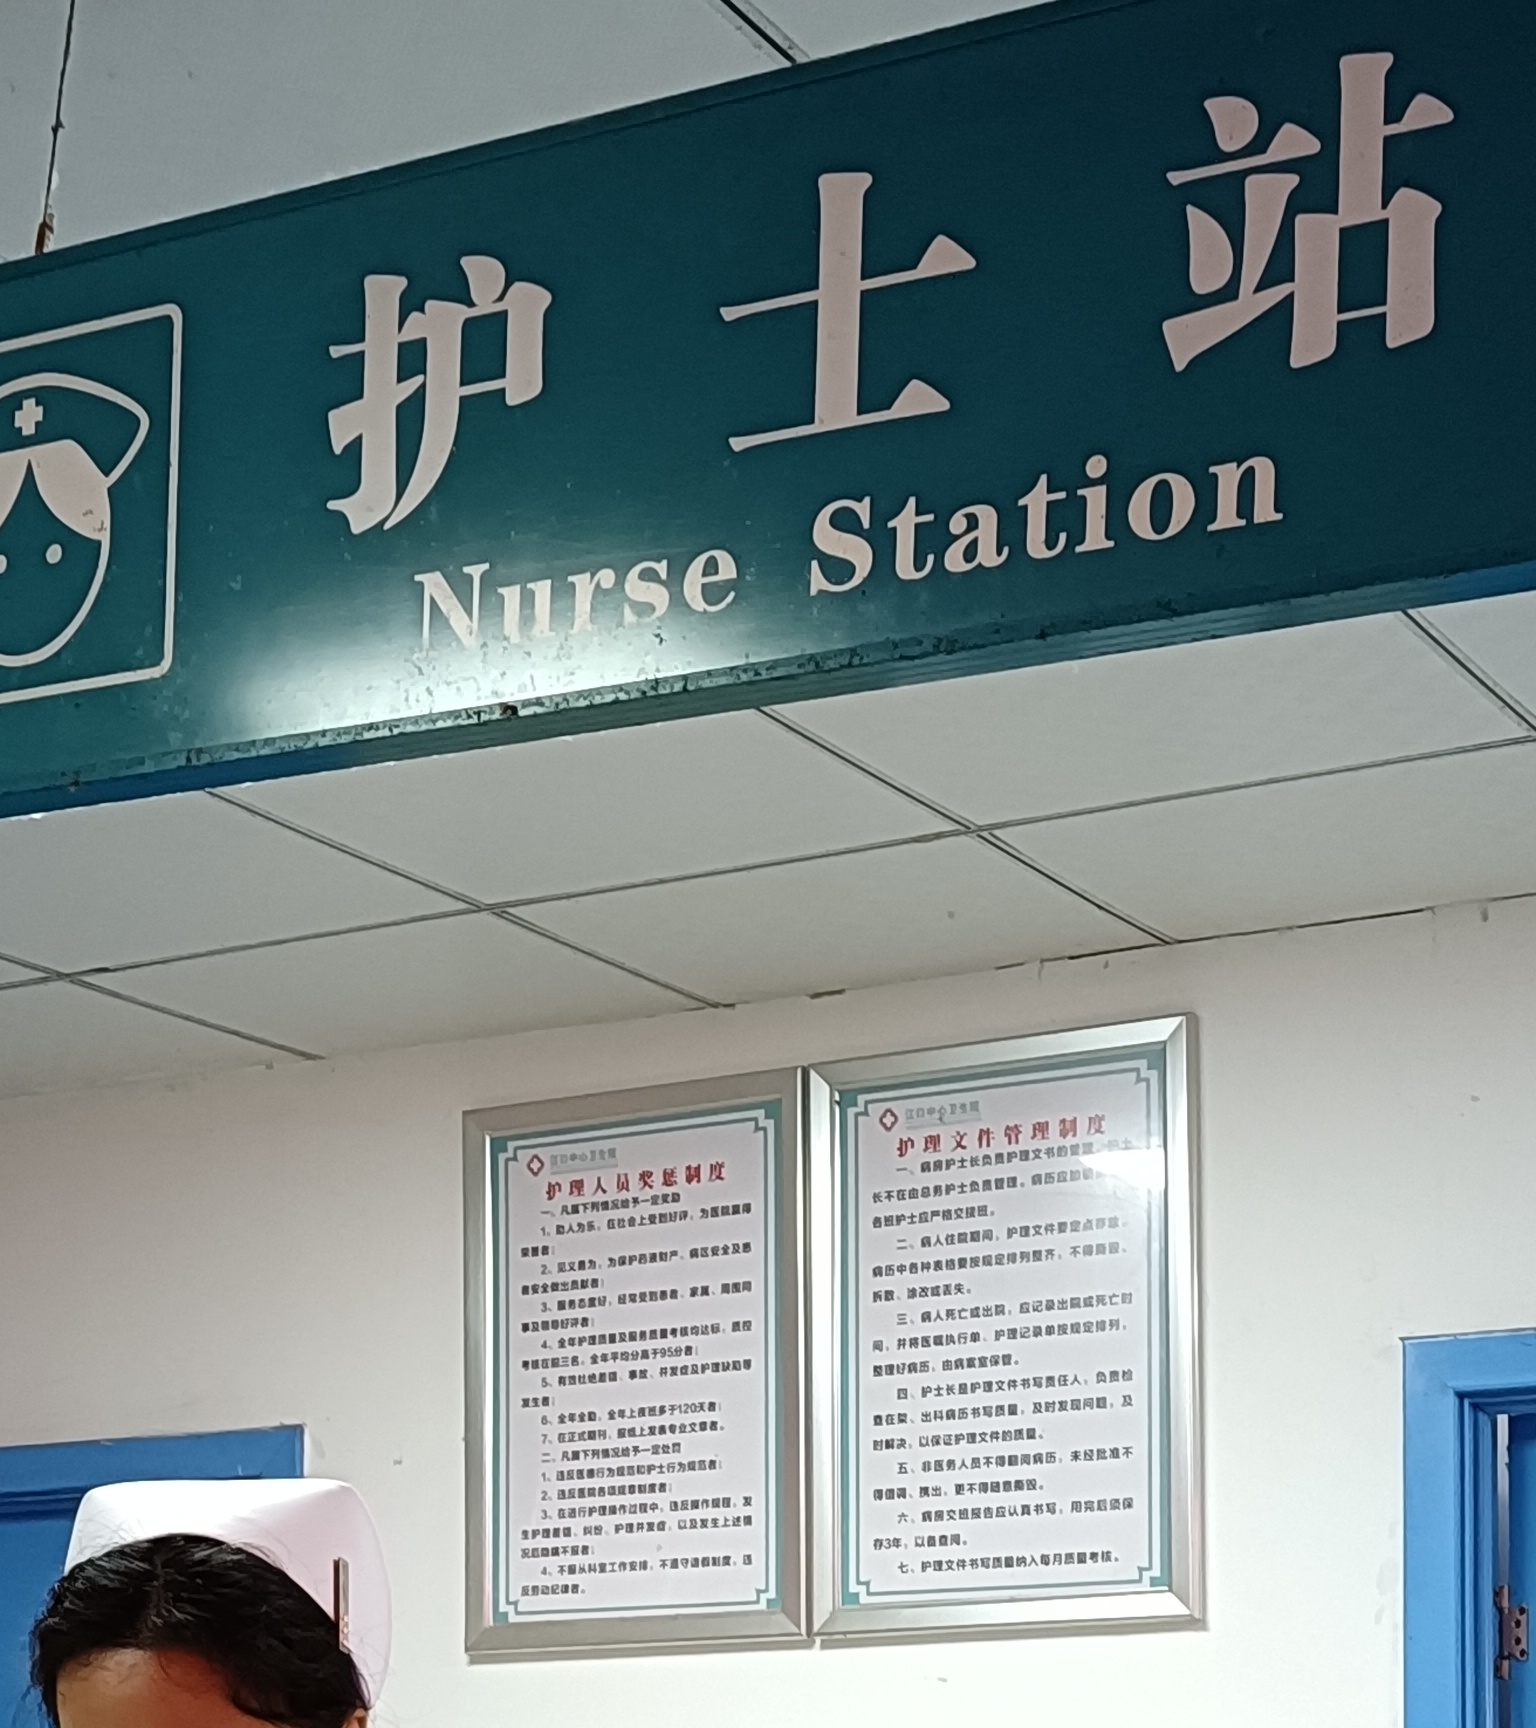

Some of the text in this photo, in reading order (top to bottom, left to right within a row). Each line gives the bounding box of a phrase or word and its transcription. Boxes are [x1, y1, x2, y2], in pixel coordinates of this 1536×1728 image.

[327, 52, 1455, 536] 护士站
[414, 452, 1283, 652] Nurse Station
[545, 1161, 724, 1200] 护理人员奖惩制度
[896, 1114, 1104, 1157] 护理文件管理制度
